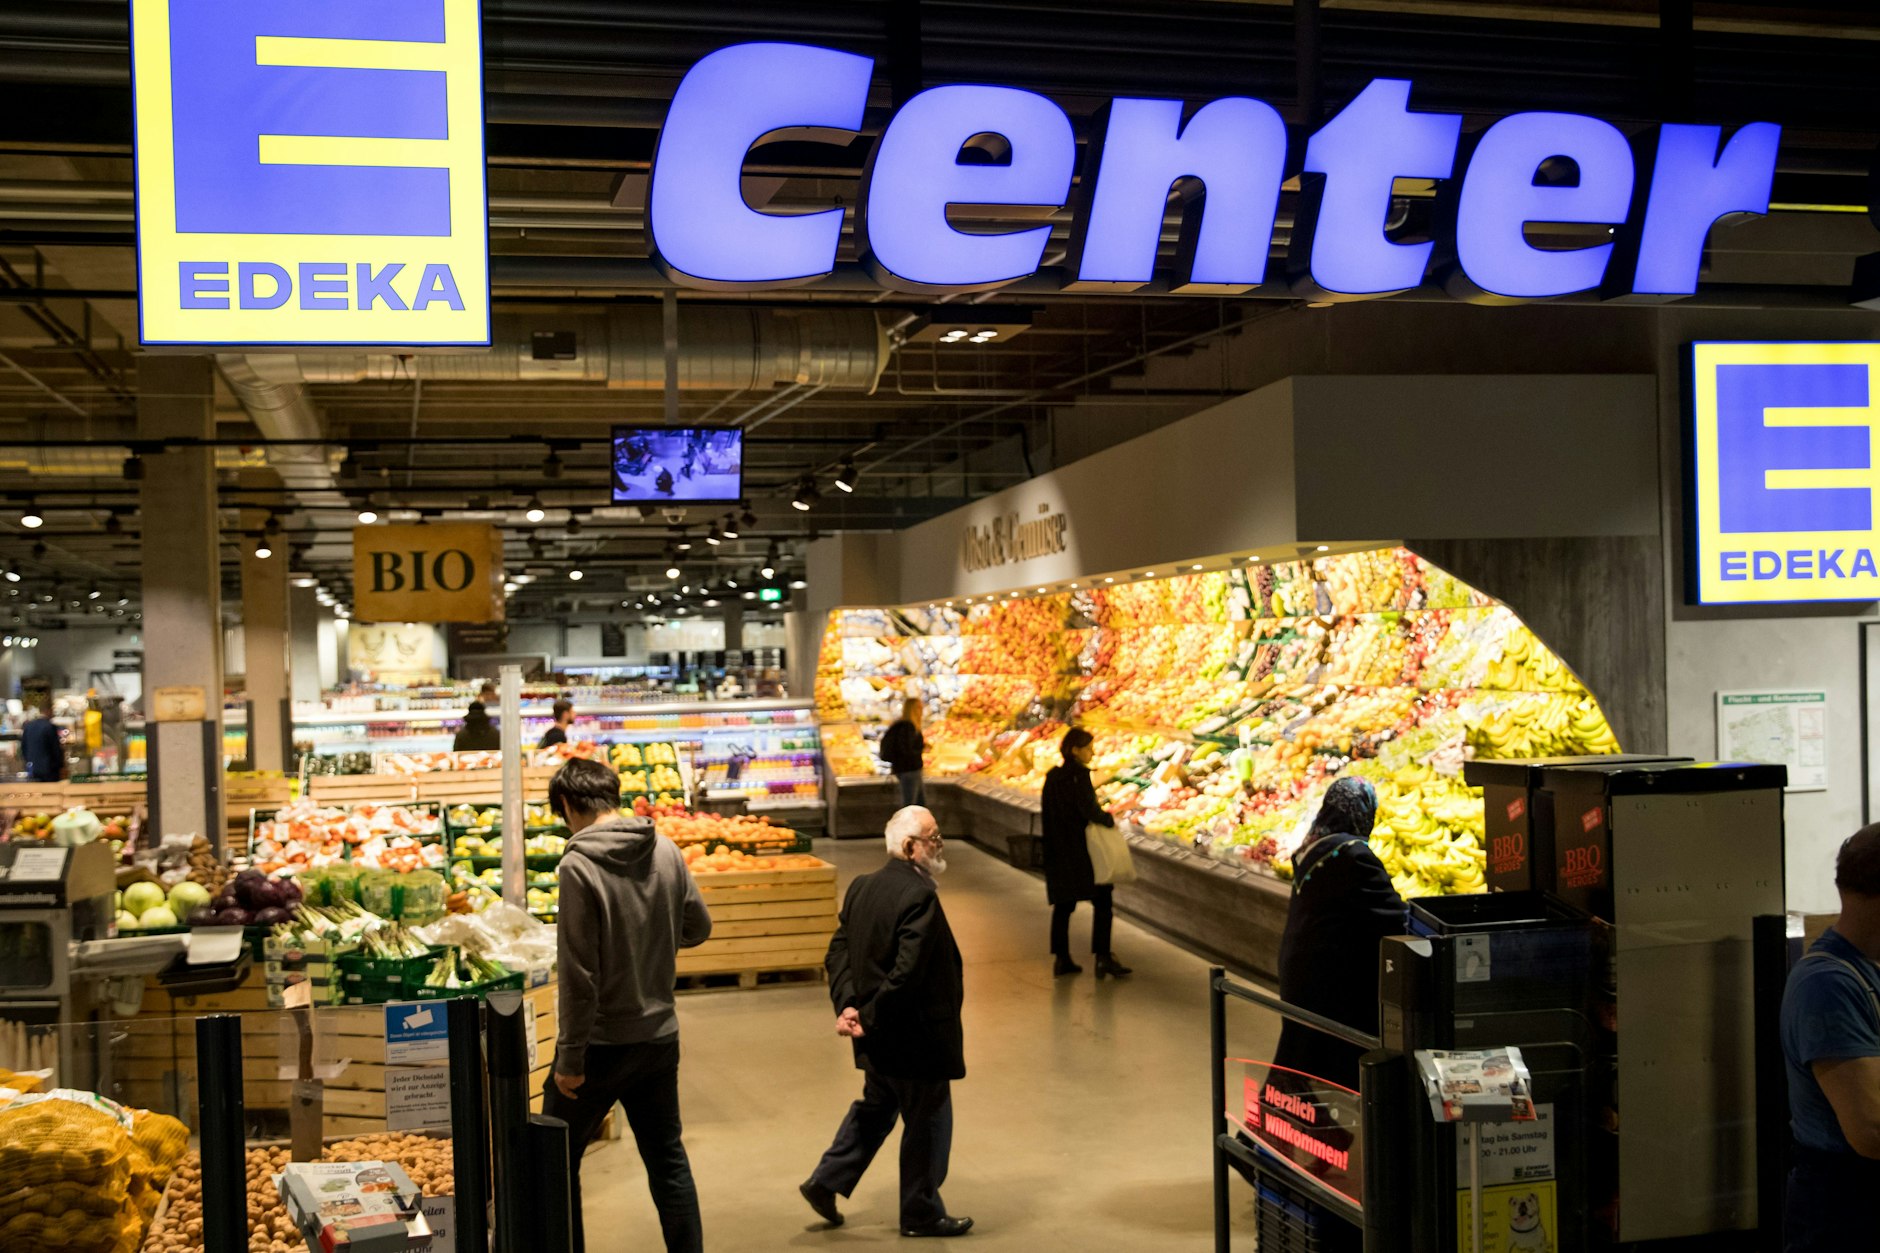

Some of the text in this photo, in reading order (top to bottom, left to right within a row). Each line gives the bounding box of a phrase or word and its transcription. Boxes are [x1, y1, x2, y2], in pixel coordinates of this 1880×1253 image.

[650, 42, 1783, 298] Center
[178, 260, 466, 311] EDEKA
[1716, 364, 1873, 534] E
[369, 548, 476, 593] BIO
[1719, 548, 1880, 581] EDEKA
[1493, 833, 1523, 860] BBQ
[1565, 845, 1601, 873] BBQ
[393, 1075, 411, 1083] Jeder
[420, 1082, 447, 1090] Anzeige
[1265, 1084, 1316, 1124] Herzlich
[1265, 1113, 1349, 1172] Willkommen!
[1463, 1131, 1548, 1145] Mtag bis Samstag
[1498, 1147, 1521, 1156] 21.00
[1522, 1145, 1537, 1153] Uhr
